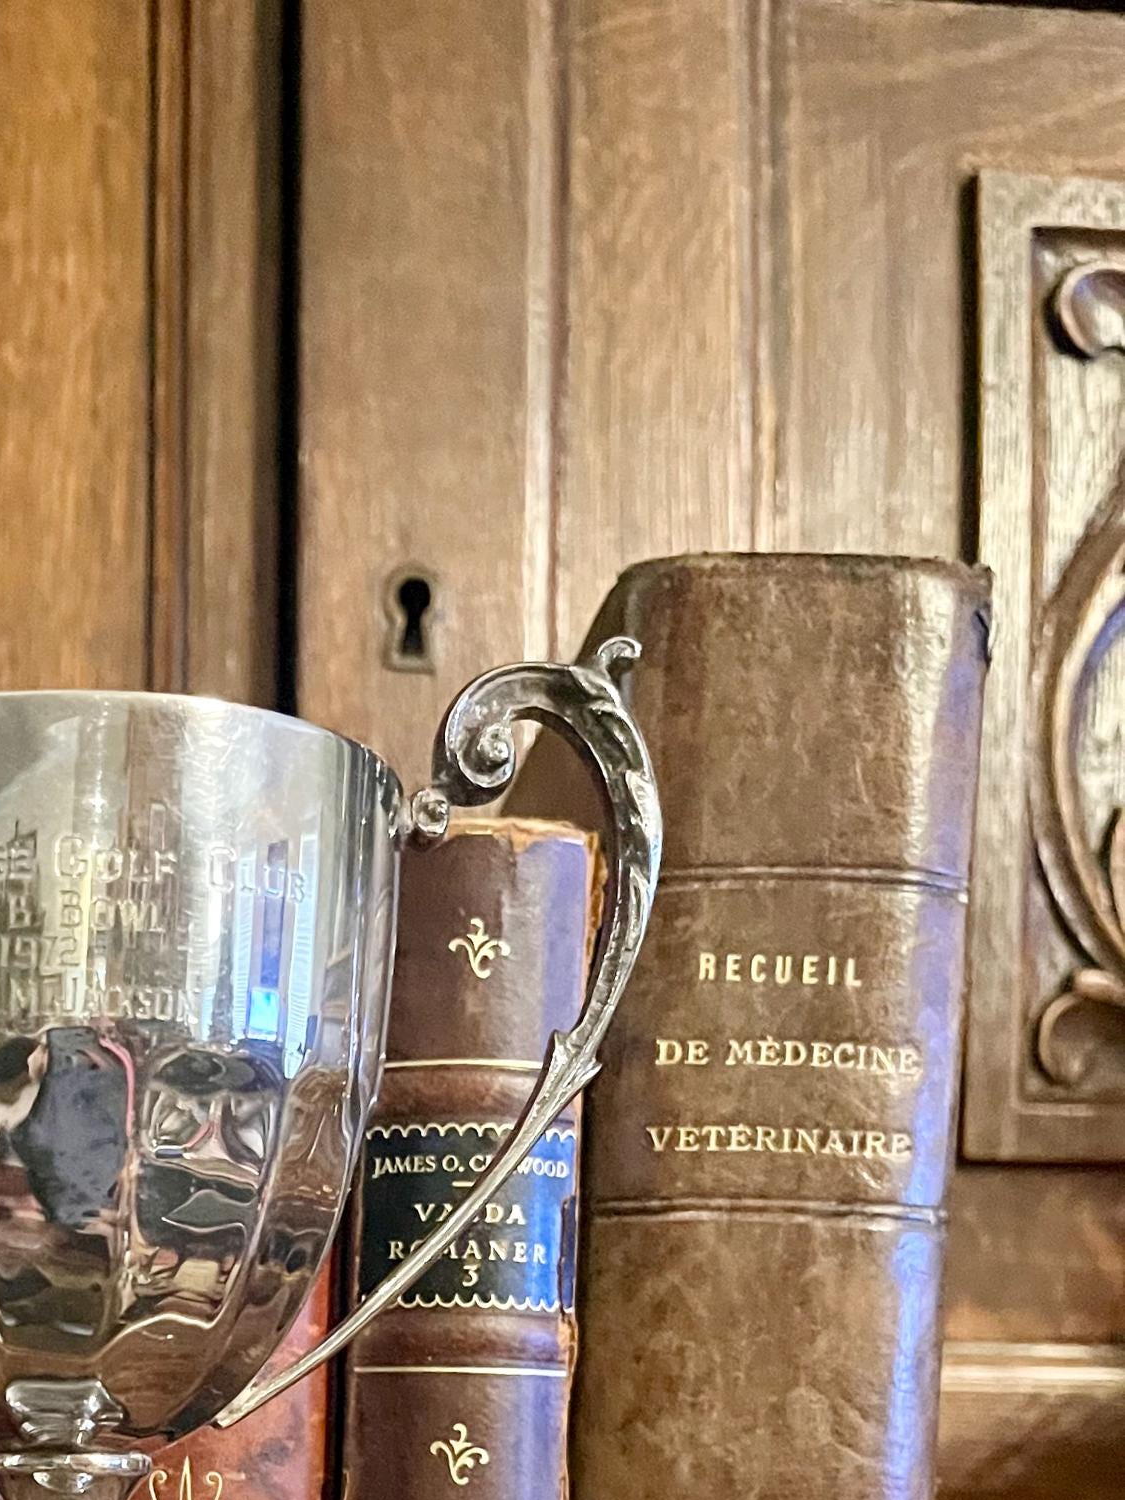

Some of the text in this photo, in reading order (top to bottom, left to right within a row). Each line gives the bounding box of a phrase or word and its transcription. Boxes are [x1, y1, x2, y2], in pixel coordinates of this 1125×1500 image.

[54, 834, 178, 884] GOLF
[206, 845, 307, 904] CLUB
[59, 888, 169, 935] BOWL
[697, 950, 863, 988] RECUEIL
[655, 1038, 709, 1066] DE
[372, 1155, 437, 1178] JAMES
[469, 1156, 570, 1178] CWOOD
[414, 1203, 526, 1225] VADA
[462, 1264, 481, 1287] 3
